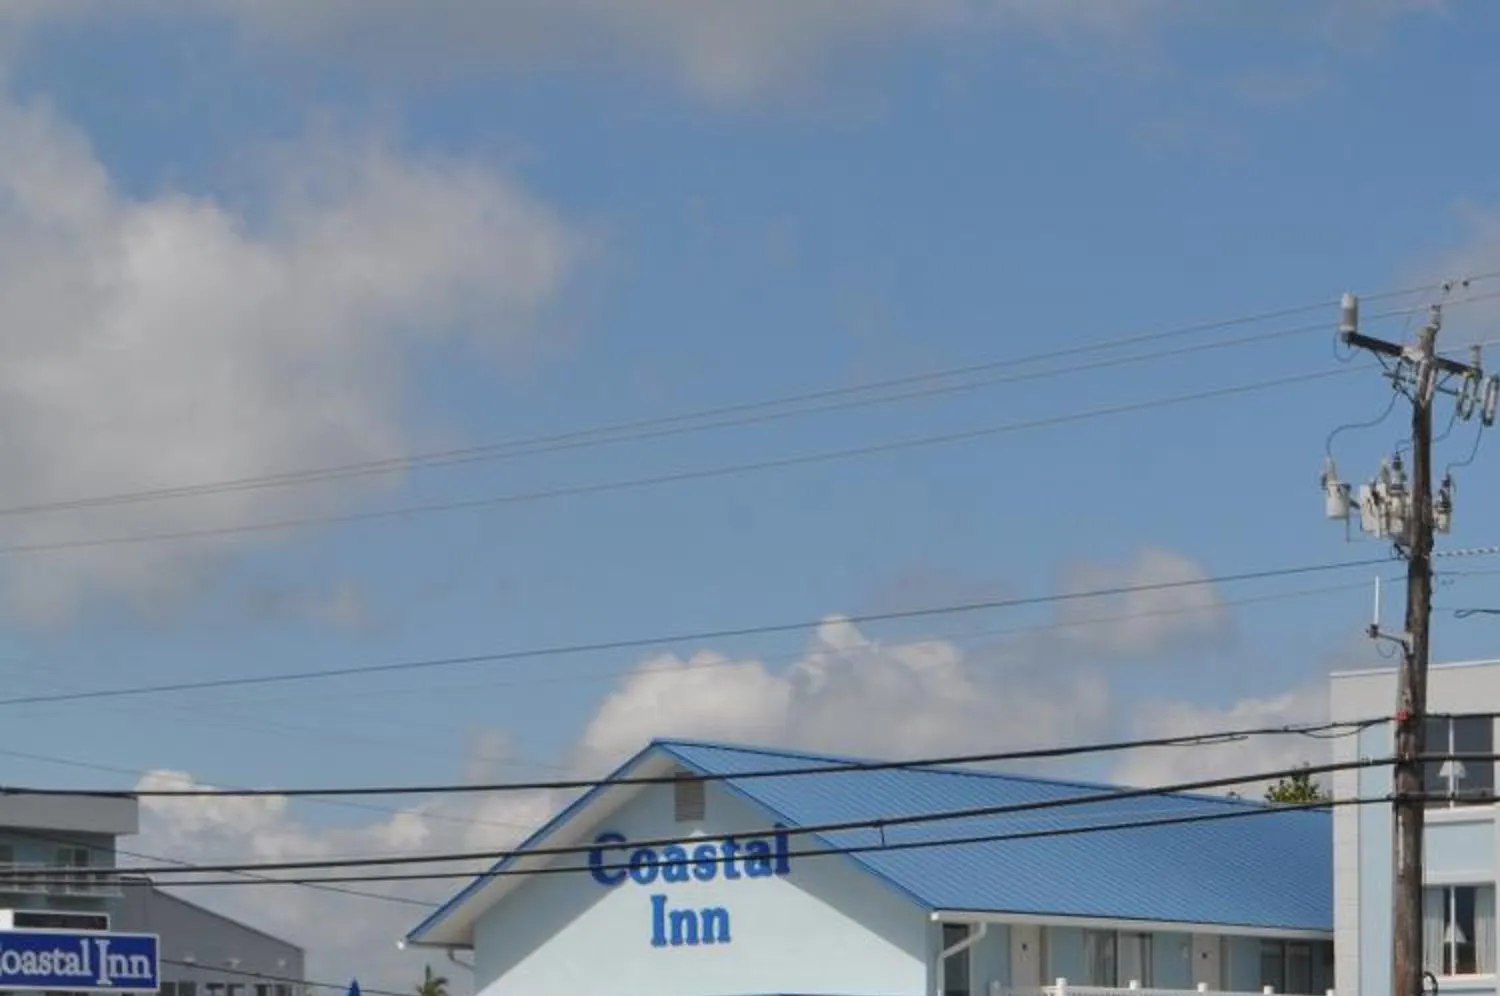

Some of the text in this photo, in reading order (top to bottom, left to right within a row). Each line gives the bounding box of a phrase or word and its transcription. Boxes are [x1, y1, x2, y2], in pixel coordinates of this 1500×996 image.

[588, 822, 790, 886] Coastal
[650, 894, 731, 947] Inn
[0, 938, 152, 985] oastal Inn
